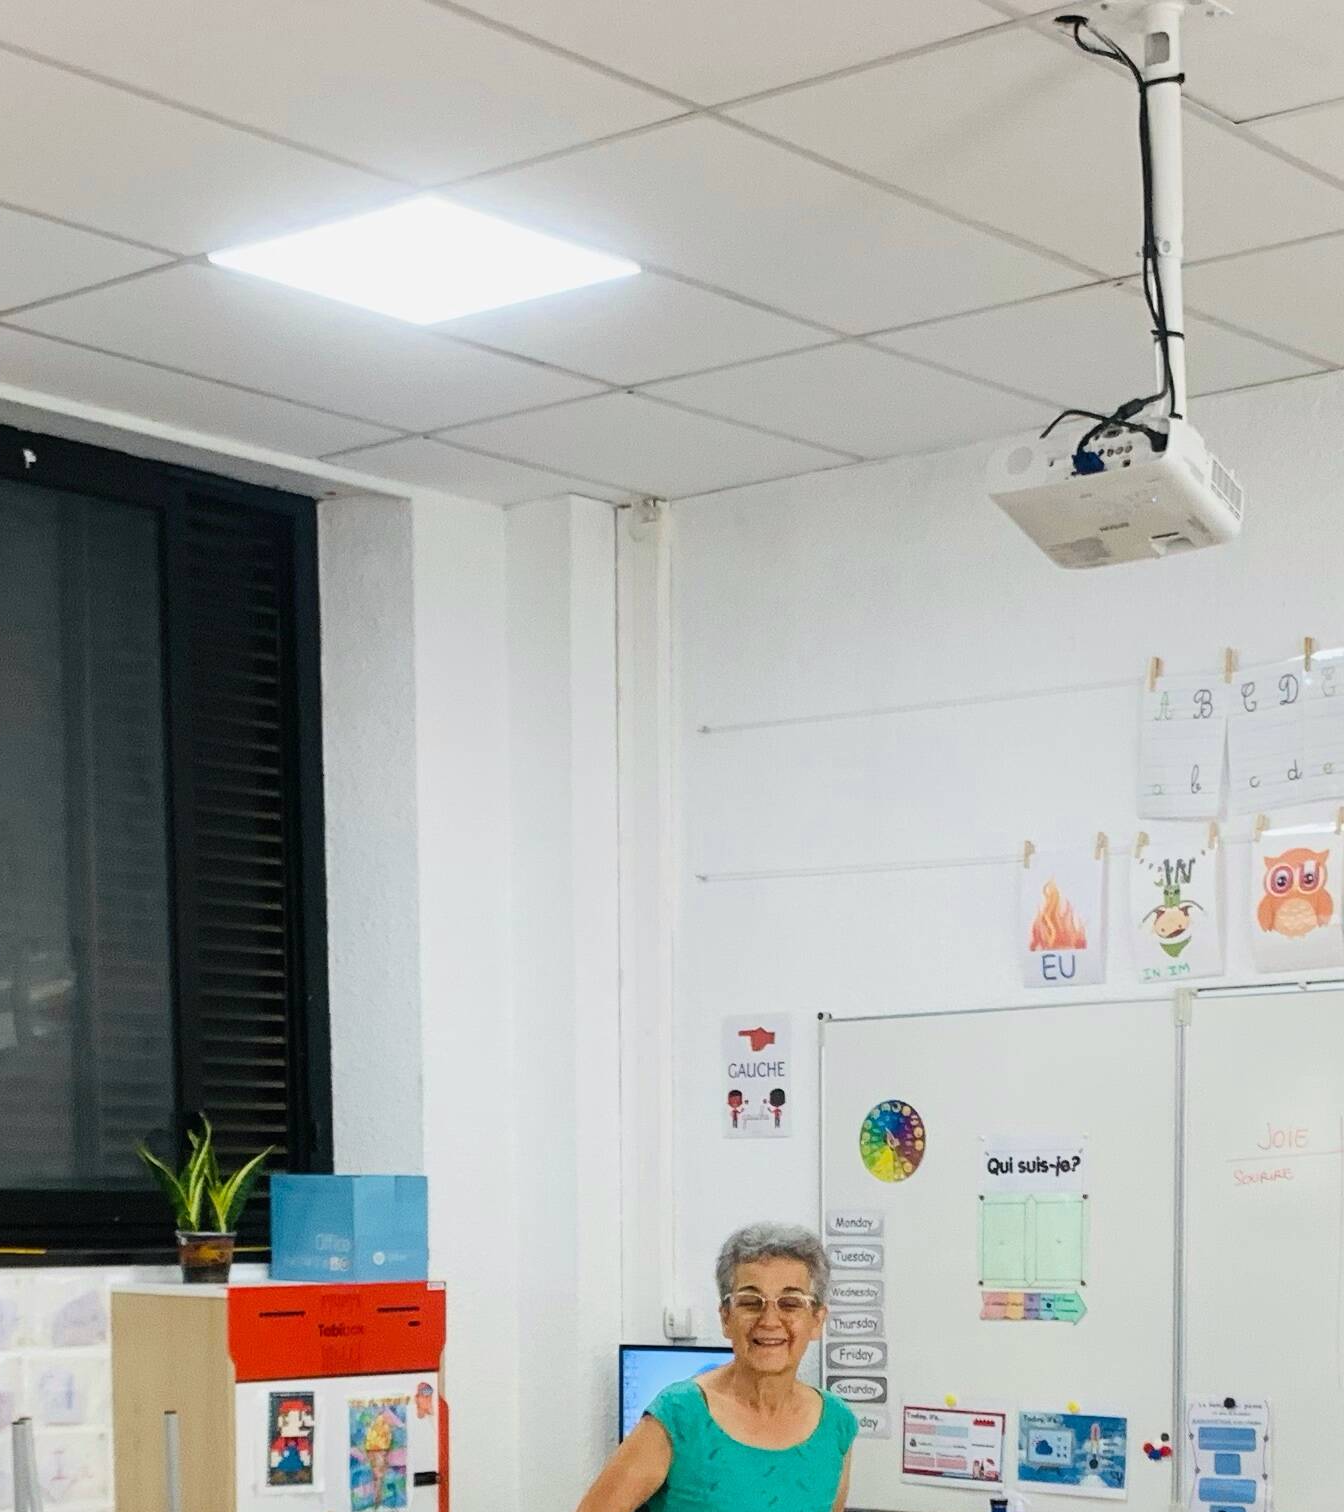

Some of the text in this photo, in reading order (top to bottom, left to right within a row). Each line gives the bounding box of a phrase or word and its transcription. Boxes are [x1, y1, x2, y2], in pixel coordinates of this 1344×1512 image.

[1042, 954, 1076, 981] EU
[728, 1061, 785, 1078] GAUCHE
[987, 1157, 1013, 1175] Qui
[835, 1217, 873, 1231] Monday
[834, 1250, 875, 1265] Tuesday
[832, 1287, 879, 1299] Wednesday
[833, 1318, 878, 1331] Thursday
[839, 1348, 874, 1362] Friday
[836, 1383, 877, 1396] Saturday
[859, 1416, 878, 1430] day
